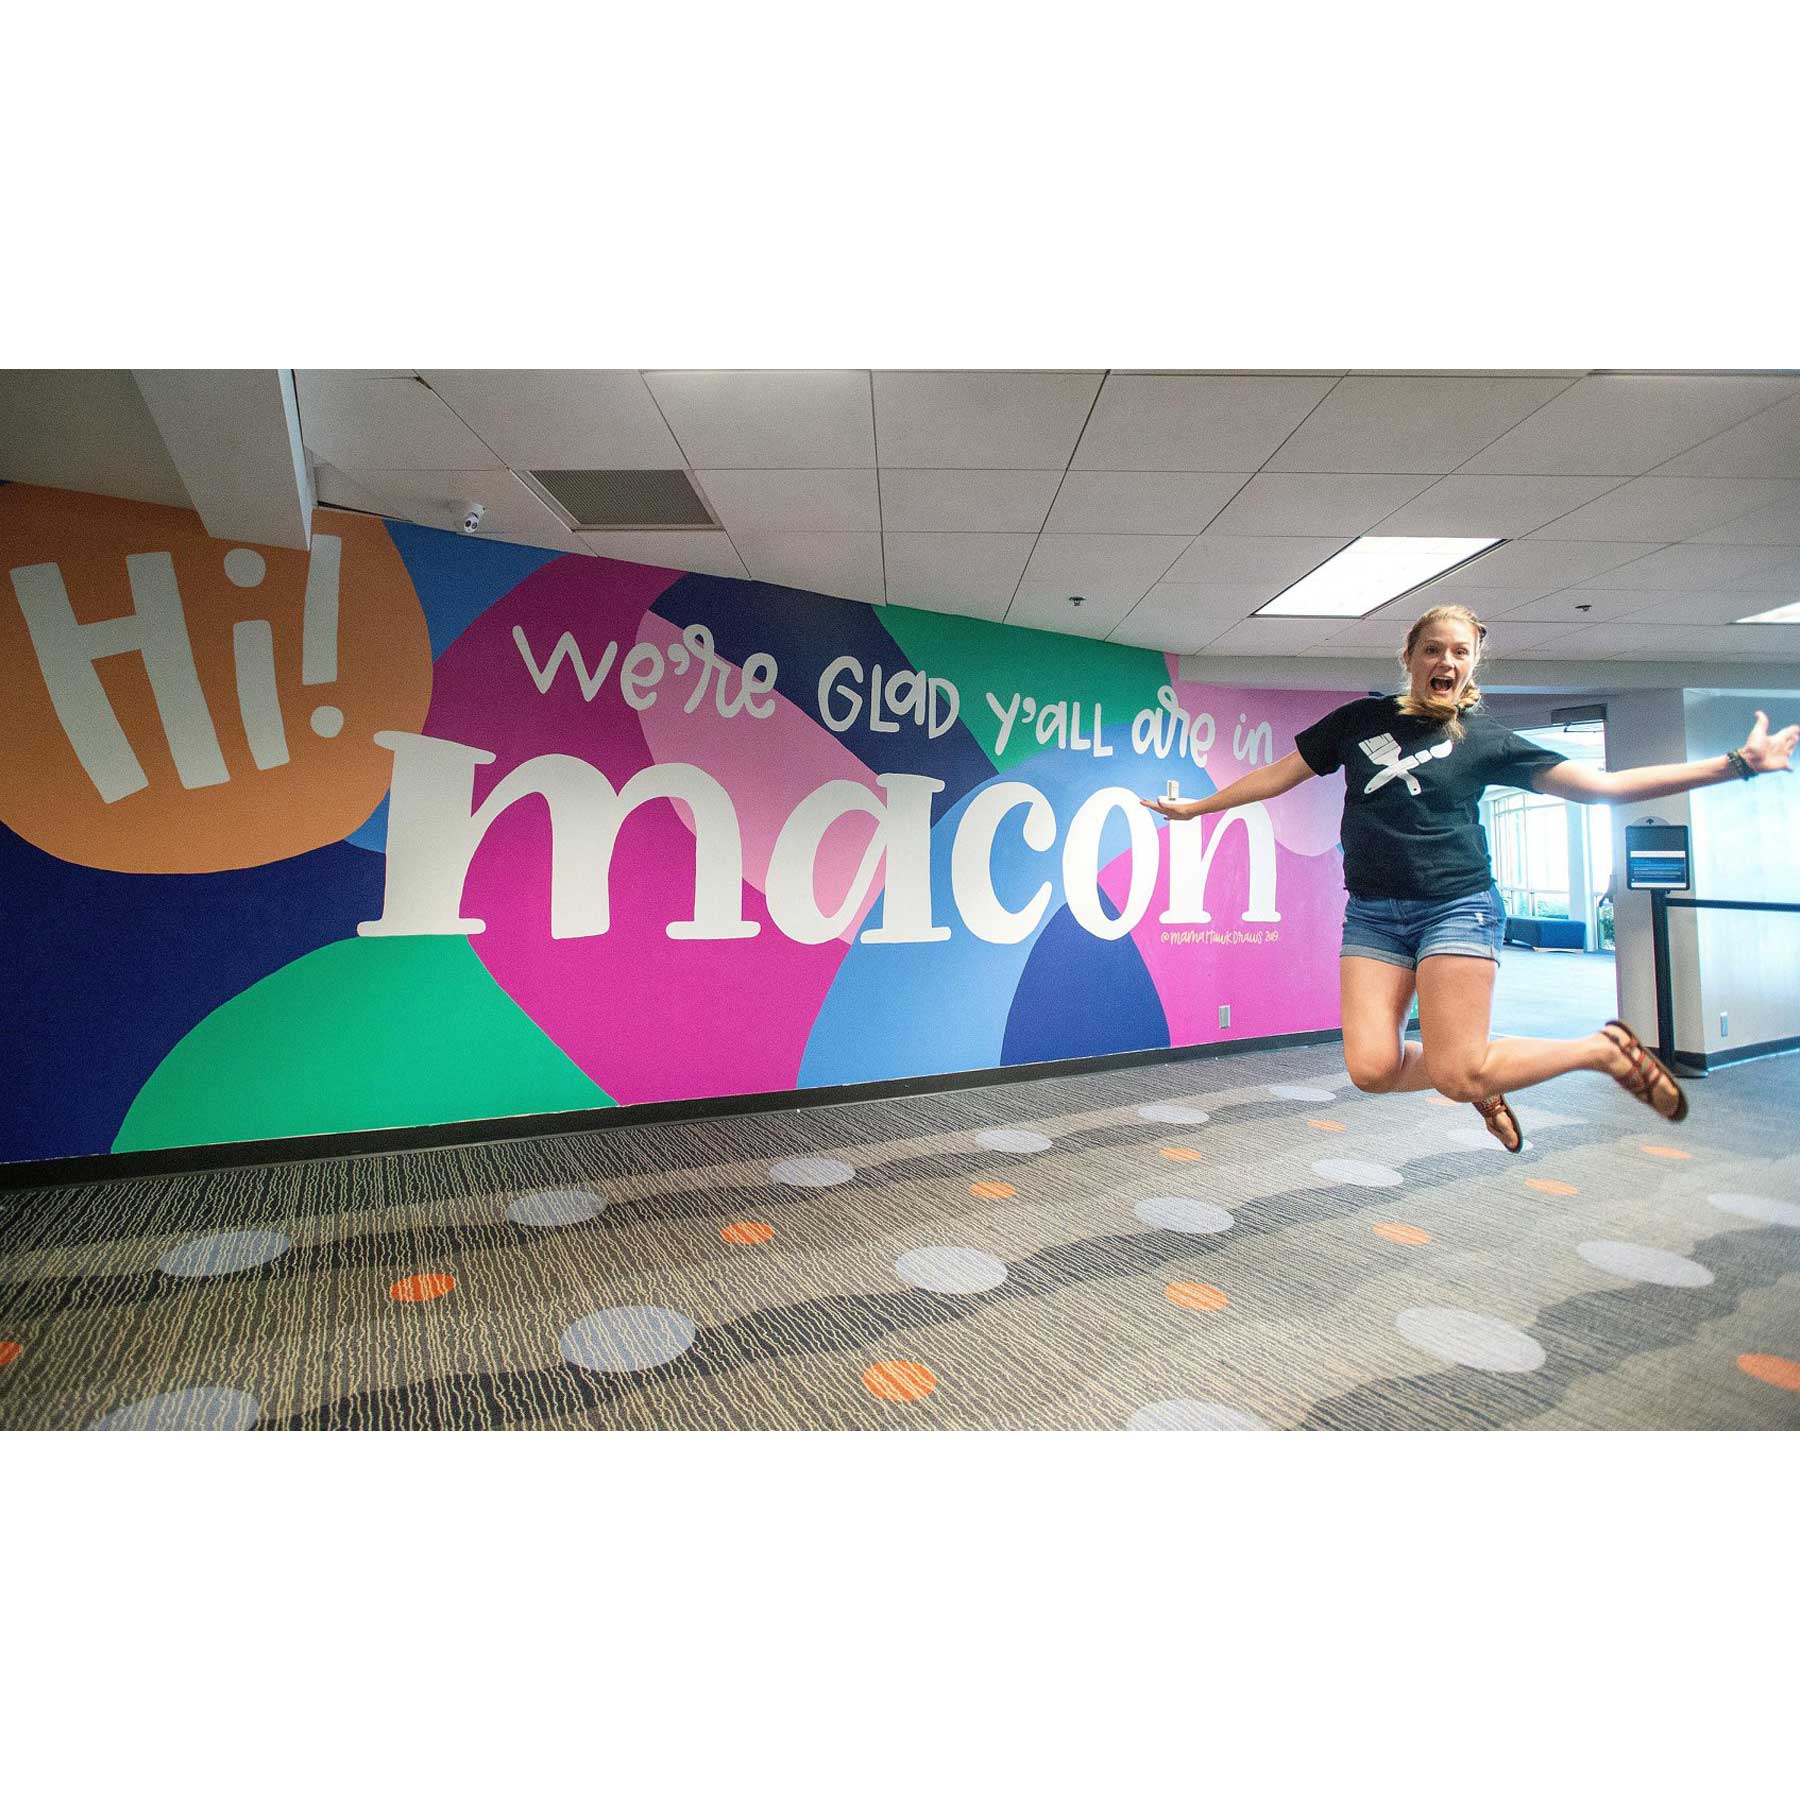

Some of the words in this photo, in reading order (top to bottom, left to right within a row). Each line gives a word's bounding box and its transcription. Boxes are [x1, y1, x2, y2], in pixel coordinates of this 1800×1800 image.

[9, 534, 344, 804] Hi!
[512, 624, 778, 718] We're
[1131, 685, 1216, 768] are
[1232, 713, 1273, 766] in
[357, 730, 1282, 945] macon
